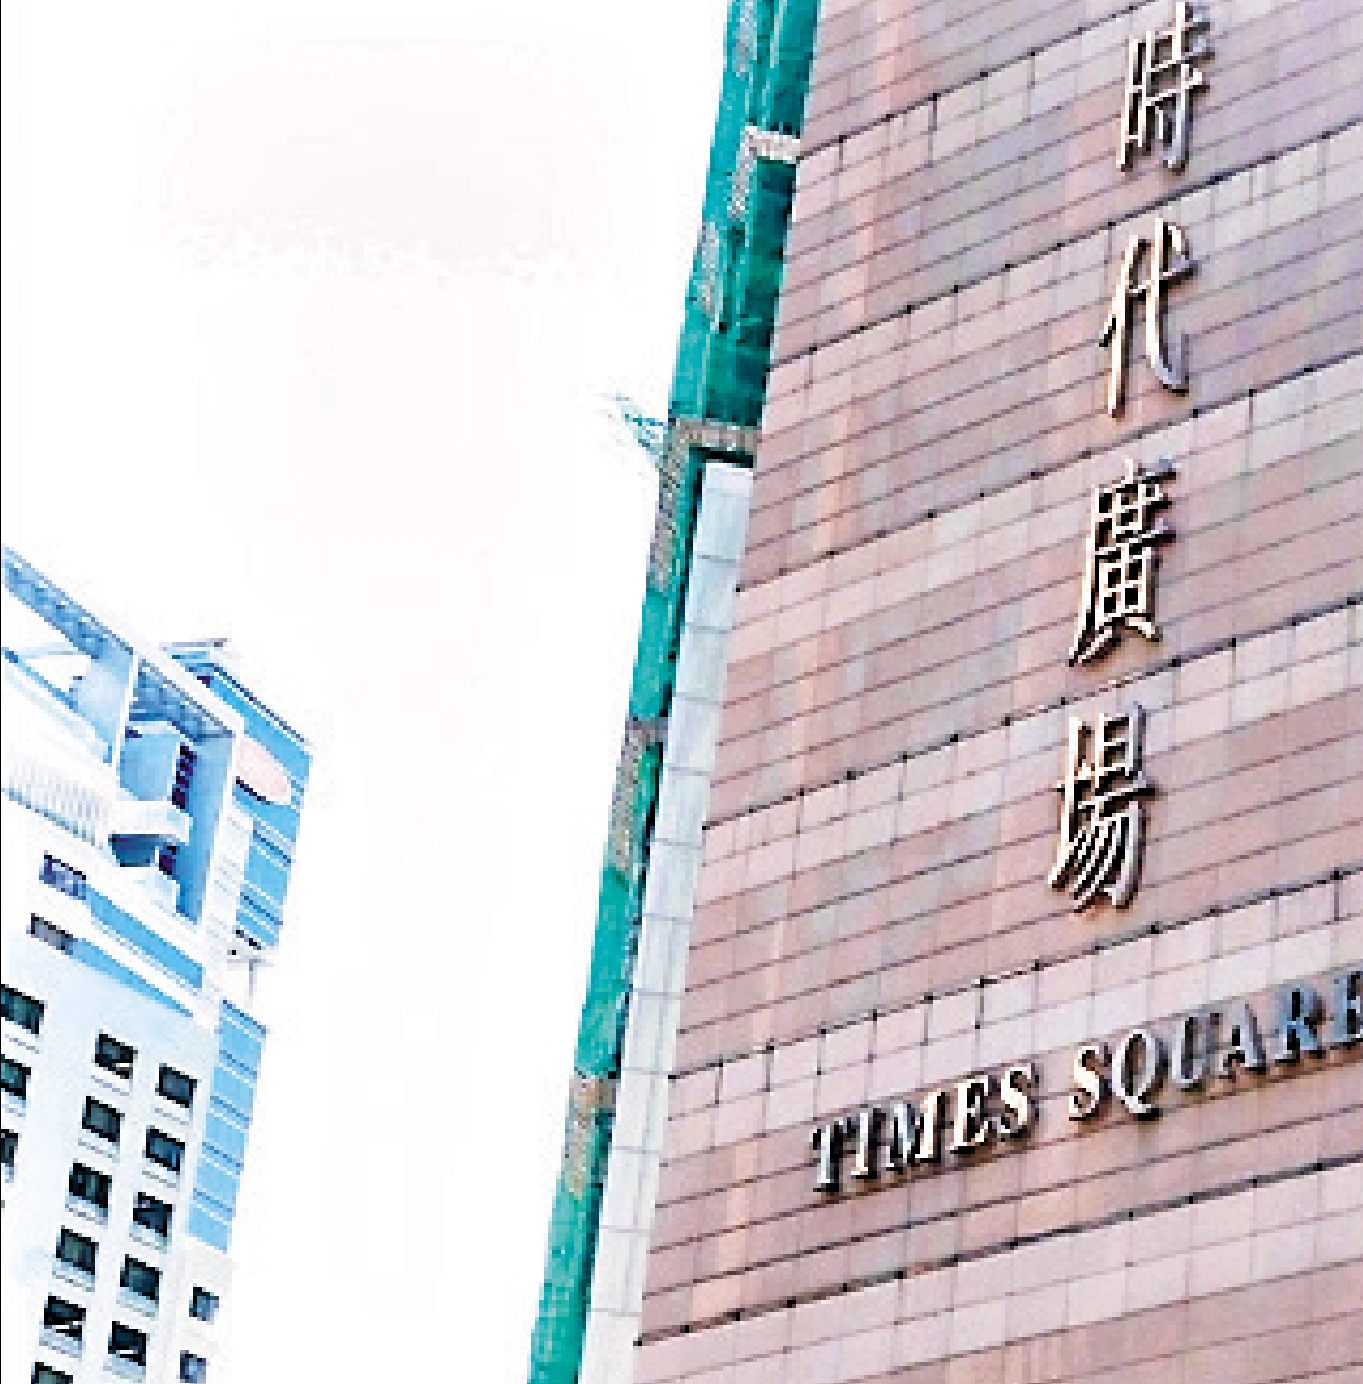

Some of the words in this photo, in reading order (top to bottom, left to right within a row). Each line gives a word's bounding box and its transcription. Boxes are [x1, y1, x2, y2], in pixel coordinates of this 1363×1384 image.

[1046, 0, 1216, 912] 時代廣場
[812, 1058, 1040, 1194] TIMES
